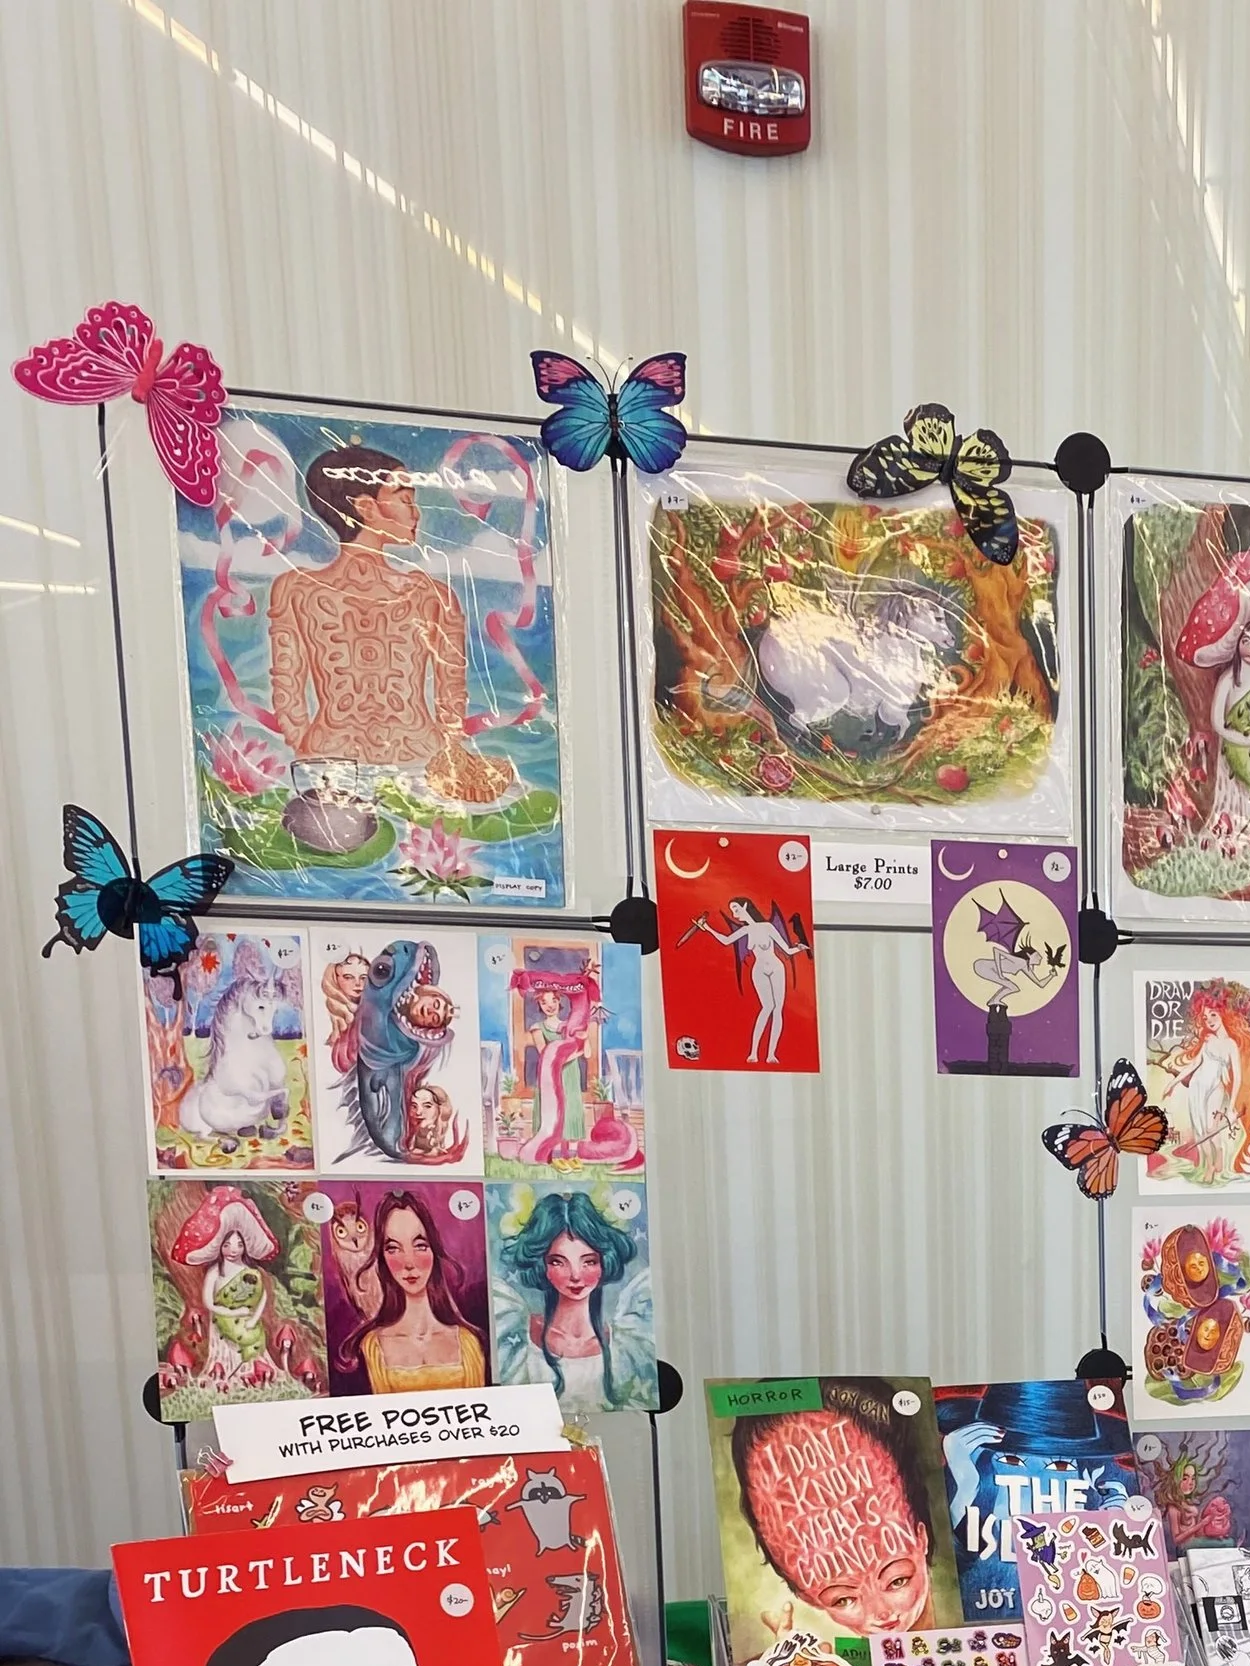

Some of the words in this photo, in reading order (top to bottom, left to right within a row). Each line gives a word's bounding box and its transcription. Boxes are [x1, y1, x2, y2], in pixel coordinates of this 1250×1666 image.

[723, 118, 779, 140] FIRE
[826, 855, 867, 876] Large
[874, 858, 919, 876] Prints
[854, 876, 892, 891] $7.00
[1149, 979, 1195, 1001] DRAW
[1151, 1000, 1183, 1019] OR
[1150, 1018, 1184, 1040] DIE
[727, 1388, 803, 1408] HORROR
[830, 1387, 859, 1402] JOY
[859, 1398, 891, 1425] SAN
[299, 1411, 373, 1437] FREE
[382, 1403, 492, 1429] POSTER
[278, 1440, 323, 1458] WITH
[330, 1431, 432, 1451] PURCHASES
[438, 1427, 484, 1441] OVER
[489, 1424, 520, 1437] $20
[764, 1444, 785, 1481] I
[783, 1455, 874, 1518] KNOW
[995, 1474, 1090, 1515] THE
[786, 1491, 883, 1555] WHAT'S
[967, 1505, 1018, 1563] ISL
[143, 1537, 462, 1603] TURTLENECK
[796, 1535, 882, 1589] GOING
[880, 1520, 918, 1555] ON
[975, 1588, 1016, 1610] JOY
